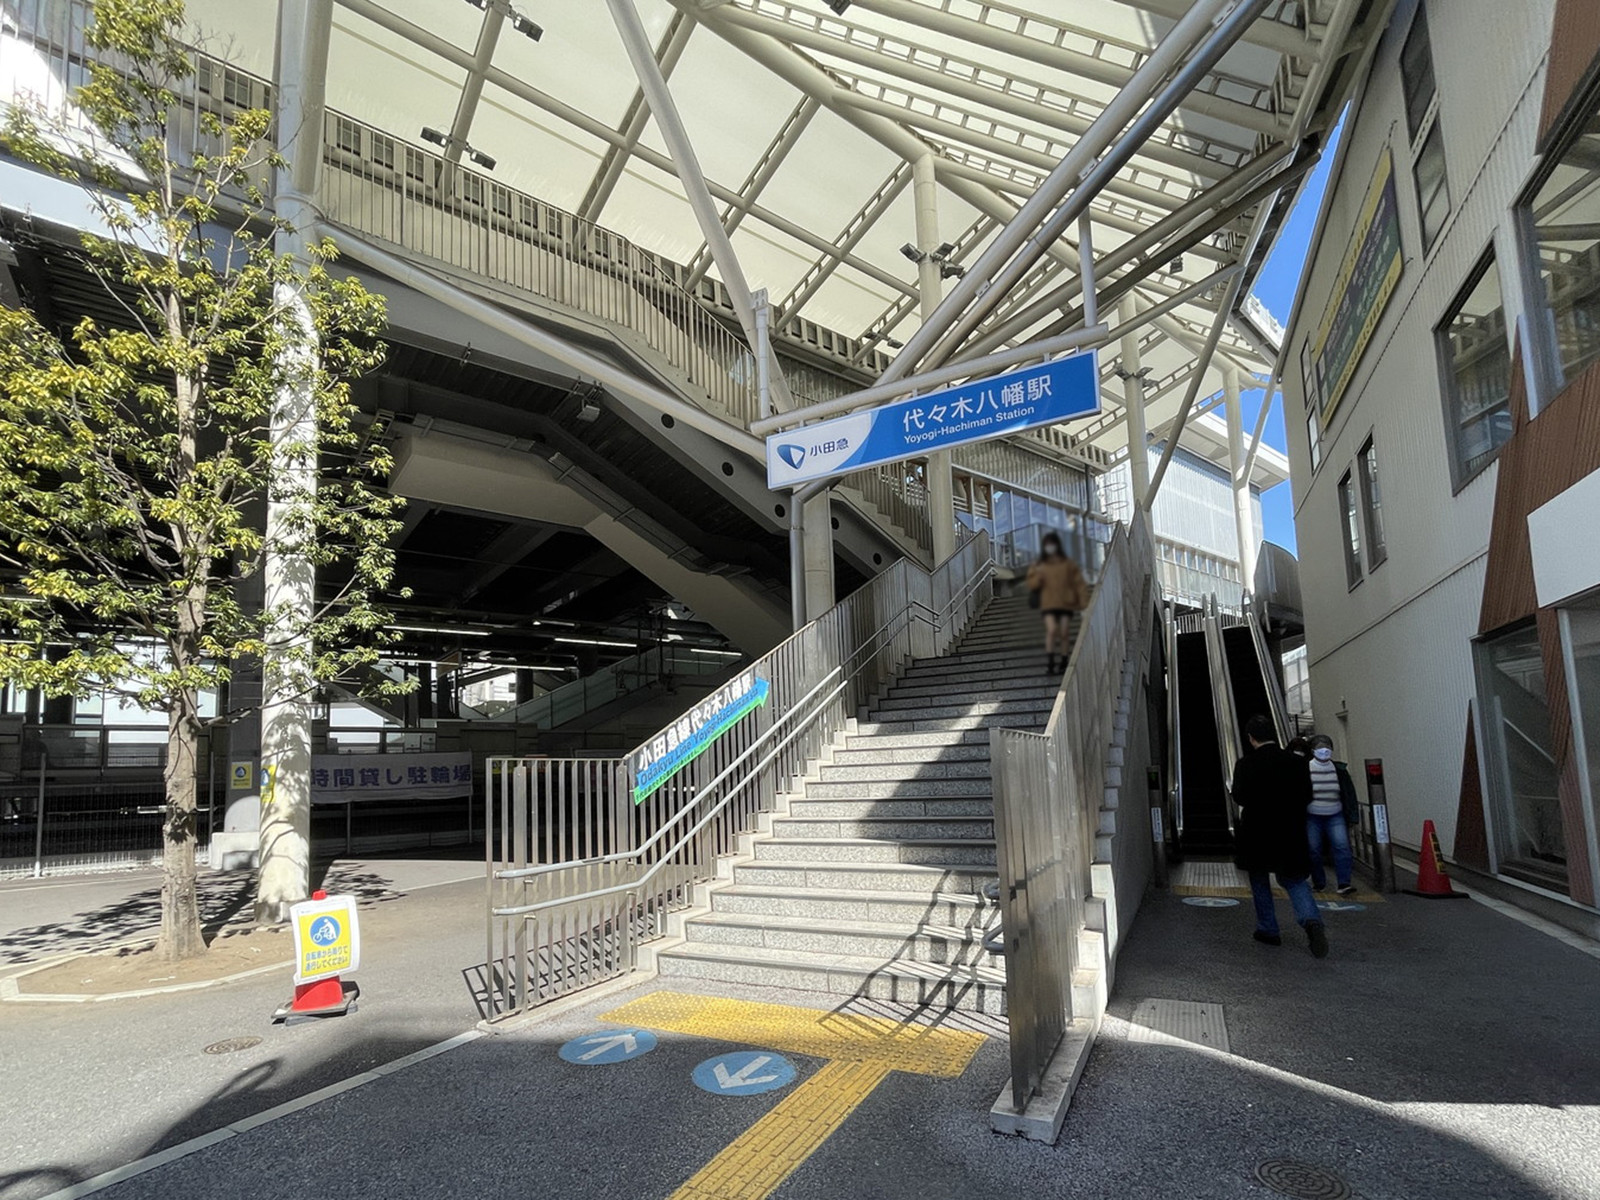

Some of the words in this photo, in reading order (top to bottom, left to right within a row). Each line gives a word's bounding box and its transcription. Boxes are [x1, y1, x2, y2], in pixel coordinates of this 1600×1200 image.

[903, 374, 1053, 433] 代々木八幡駅
[904, 416, 993, 446] Yoyogi-Hachiman
[996, 406, 1035, 423] Station
[809, 438, 850, 458] 小田急
[638, 672, 753, 771] 小田急線代々木八幡駅
[311, 764, 472, 788] 時間貸し駐輪場
[640, 755, 674, 786] Odakyu
[675, 741, 692, 760] Line
